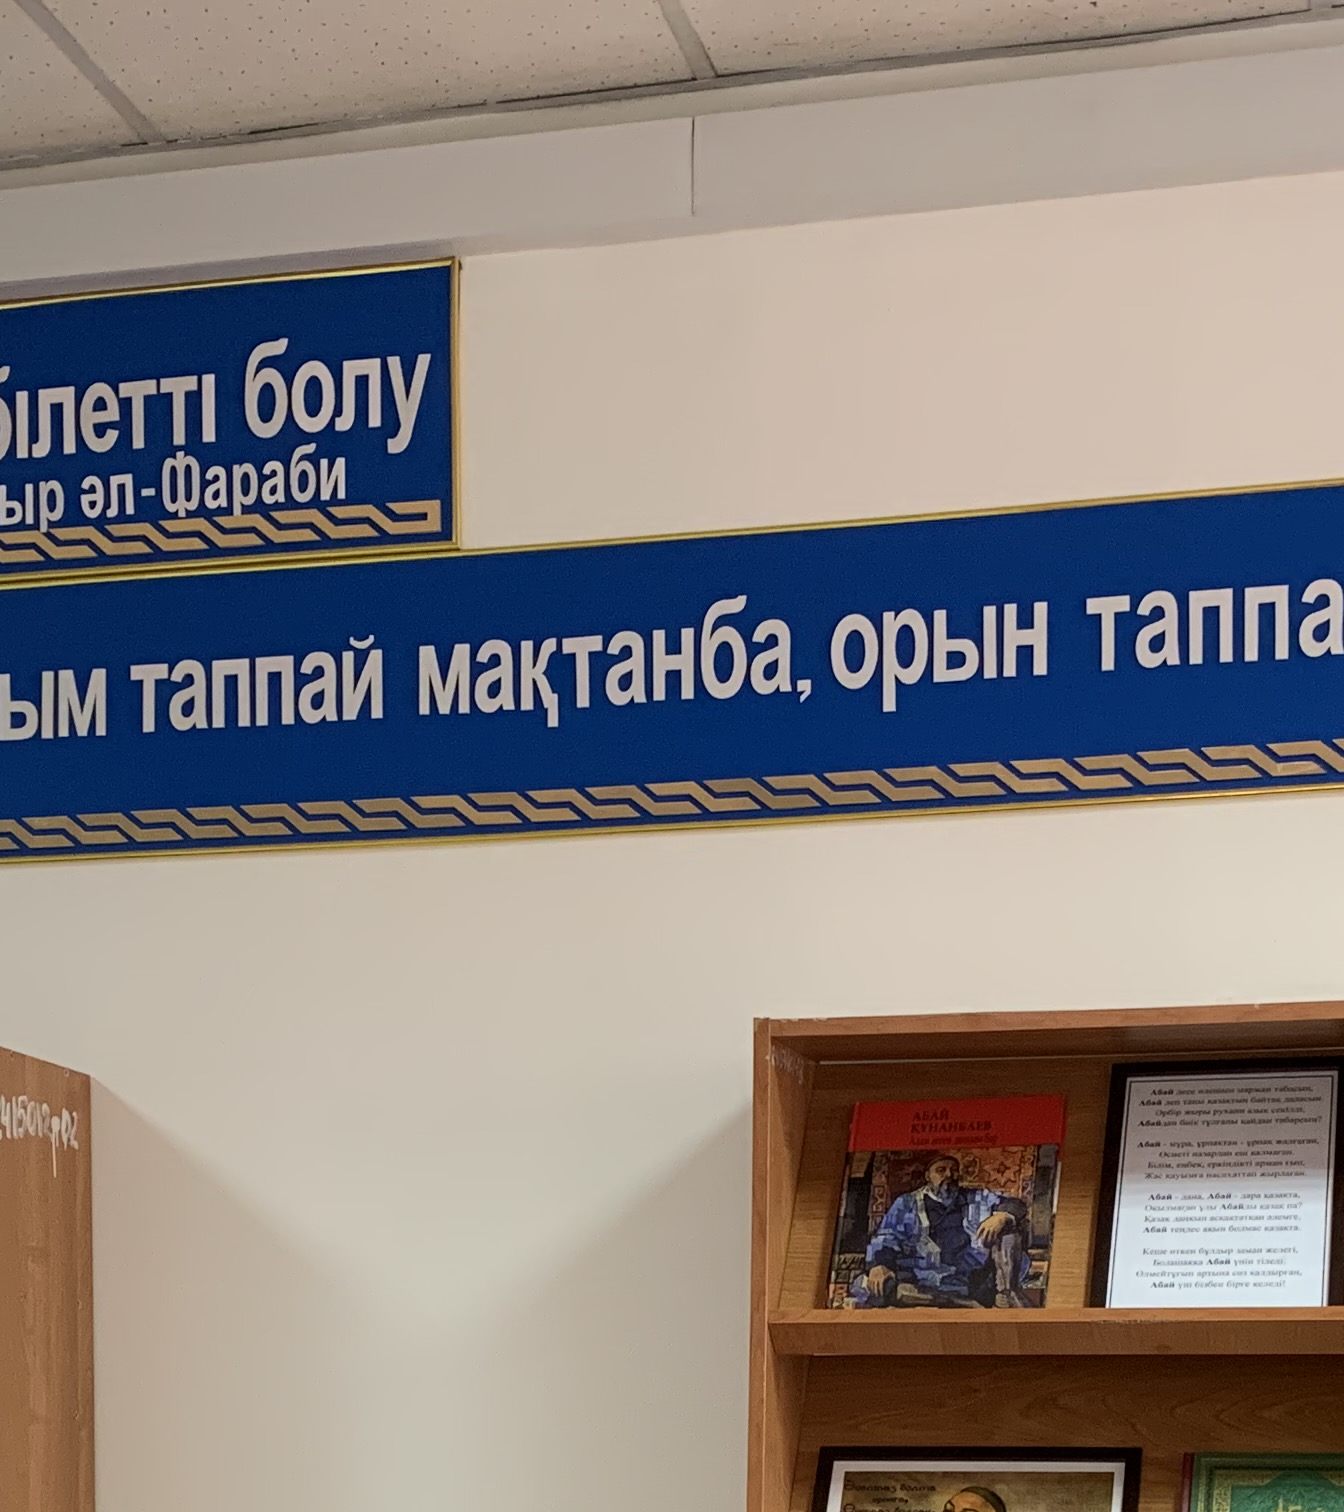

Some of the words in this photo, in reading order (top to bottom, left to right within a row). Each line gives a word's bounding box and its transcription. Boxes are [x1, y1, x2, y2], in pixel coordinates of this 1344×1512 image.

[244, 338, 432, 455] болу
[80, 442, 347, 522] әл-Фараби
[129, 634, 385, 735] таппай
[418, 595, 813, 729] мақтанба,
[830, 599, 1049, 714] орын
[913, 1108, 950, 1121] АБАЙ
